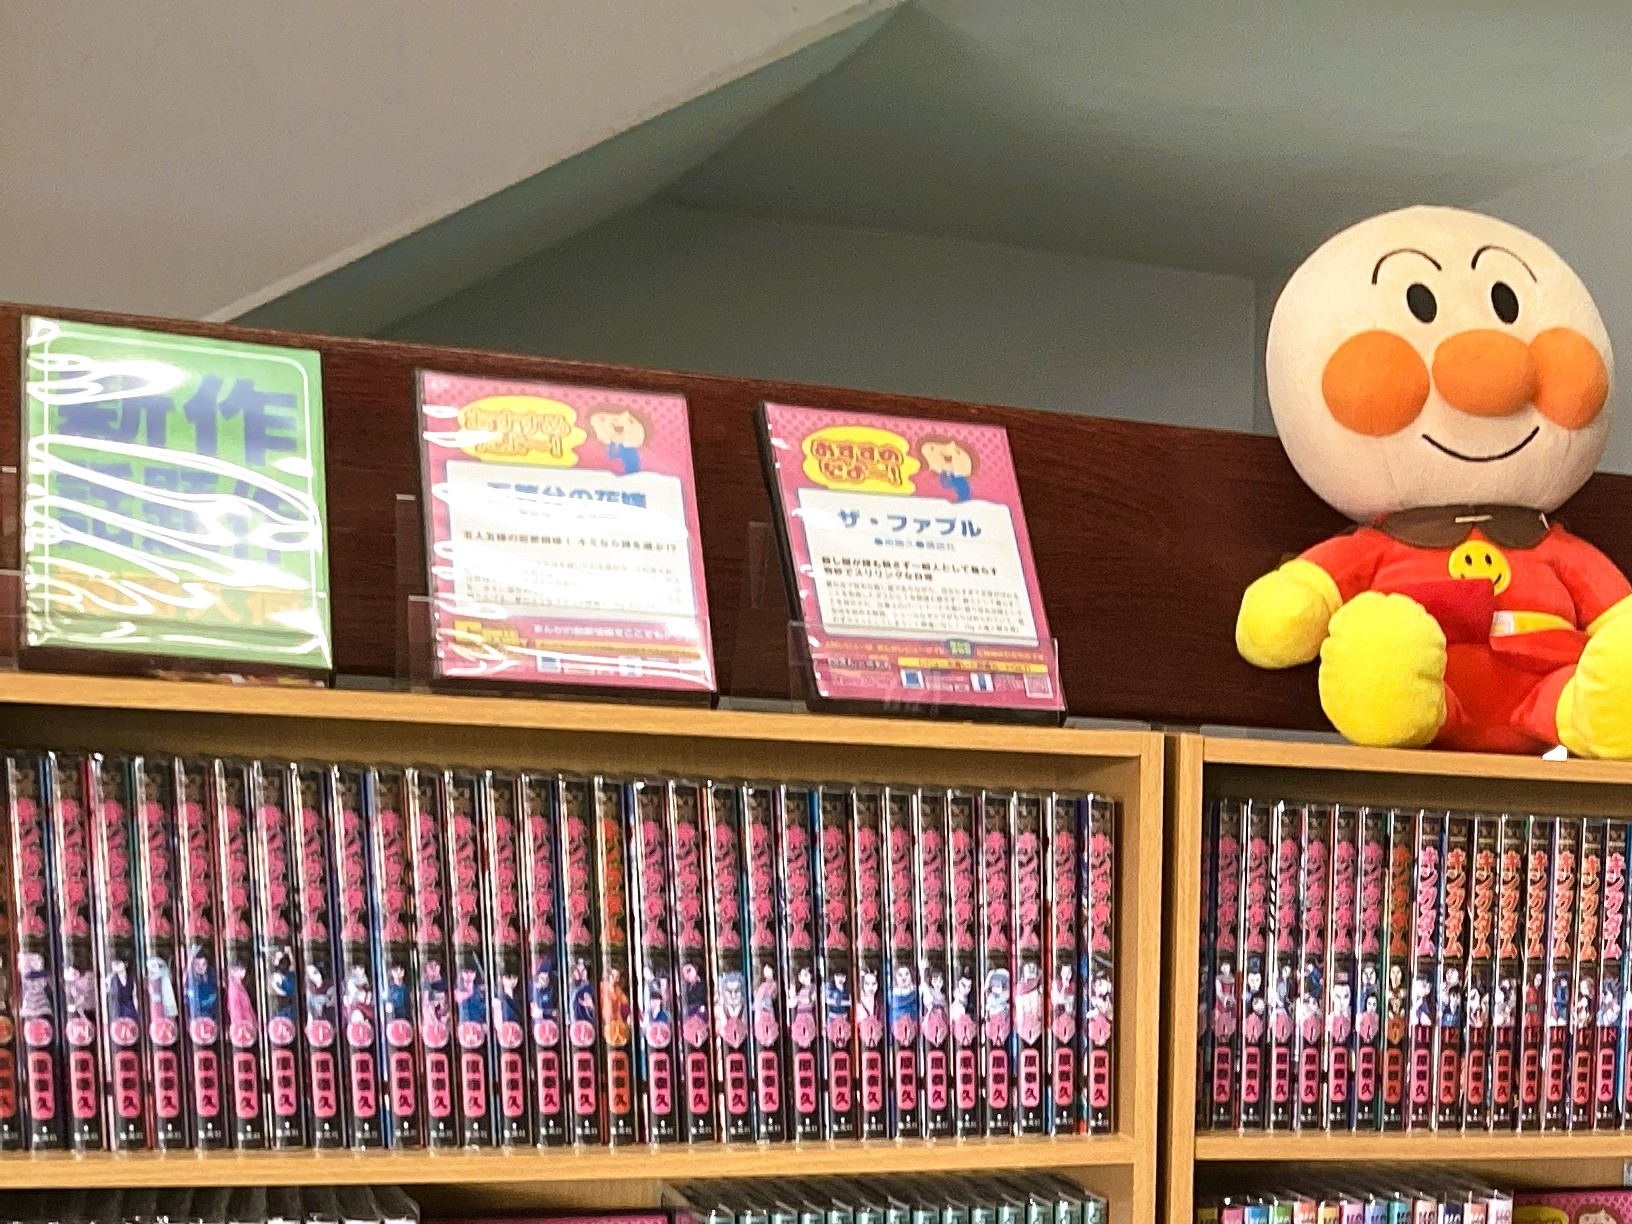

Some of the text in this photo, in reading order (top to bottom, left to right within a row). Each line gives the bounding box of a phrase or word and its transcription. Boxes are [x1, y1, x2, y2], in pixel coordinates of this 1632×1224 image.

[838, 509, 981, 538] ザ・ファブル
